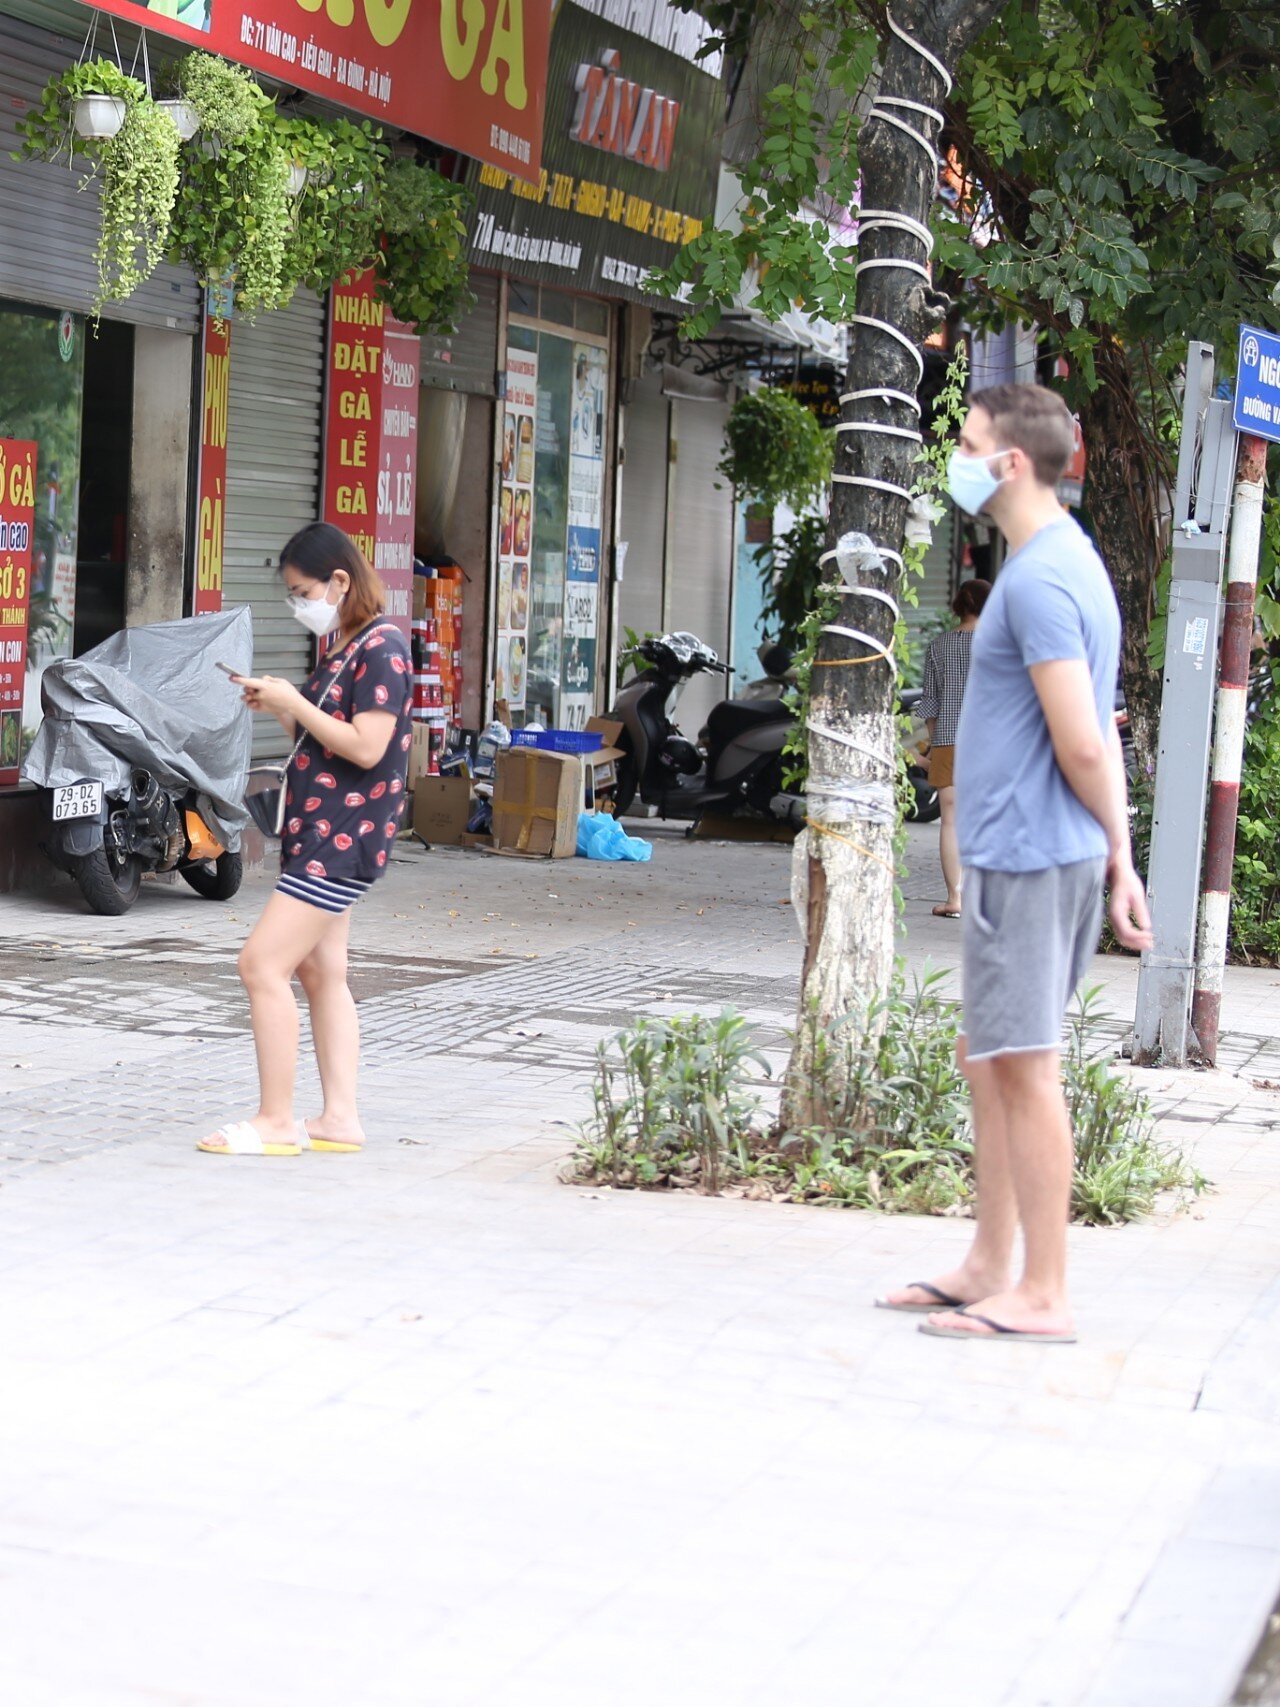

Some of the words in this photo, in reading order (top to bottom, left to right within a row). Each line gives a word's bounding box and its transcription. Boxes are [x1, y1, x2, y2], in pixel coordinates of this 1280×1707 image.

[254, 21, 265, 50] 71
[281, 32, 297, 64] CAO
[334, 293, 384, 331] NHẬN
[334, 339, 381, 378] ĐẶT
[204, 323, 231, 449] PHỞ
[339, 387, 372, 420] GÀ
[340, 430, 367, 467] LỄ
[9, 452, 35, 508] GÀ
[336, 481, 368, 515] GÀ
[8, 521, 29, 552] cao
[198, 478, 222, 591] GÀ
[16, 567, 26, 600] 3
[2, 604, 26, 625] THÁNH
[6, 640, 22, 663] CON
[55, 801, 97, 818] 073.65
[60, 784, 94, 803] 29-D2
